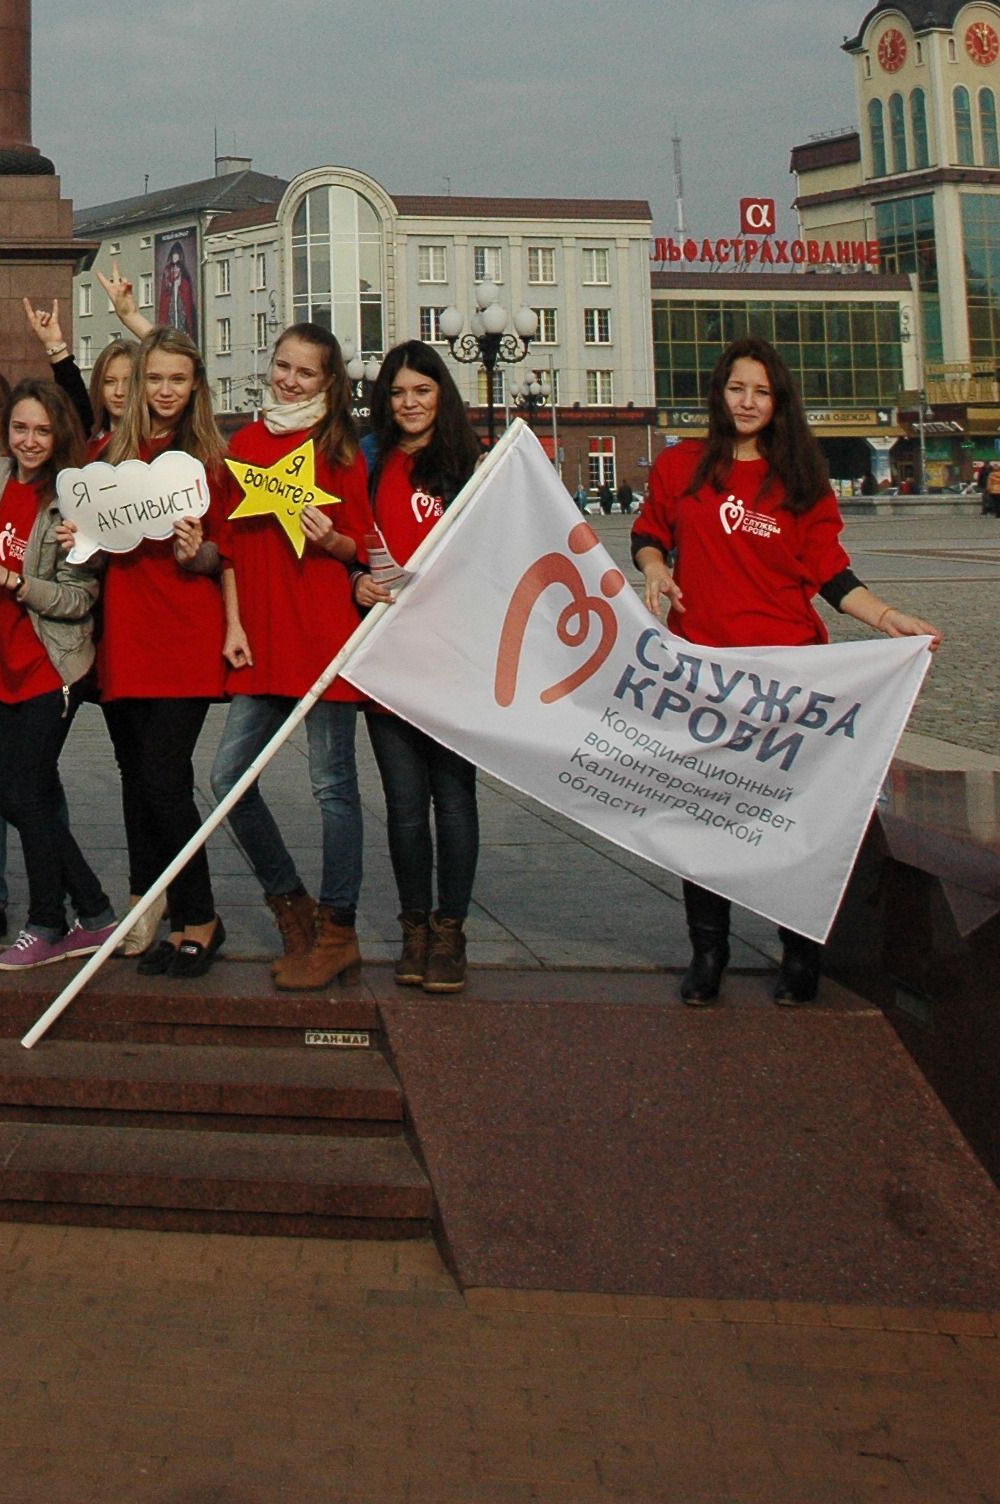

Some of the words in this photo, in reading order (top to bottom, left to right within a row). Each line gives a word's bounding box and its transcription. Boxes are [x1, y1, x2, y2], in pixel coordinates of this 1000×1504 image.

[650, 237, 881, 265] ЛЬФАСТРАХОВАНИЕ
[807, 413, 831, 422] СКАЯ
[285, 455, 306, 477] Я
[72, 481, 91, 508] Я
[635, 627, 862, 739] СЛУЖБА
[613, 663, 805, 772] КРОВИ
[599, 706, 794, 802] Координационный
[558, 770, 648, 818] области
[569, 747, 764, 847] Калининградской
[584, 731, 732, 806] волонтерский
[735, 802, 797, 833] совет
[307, 1034, 368, 1044] ГРАН-МАР
